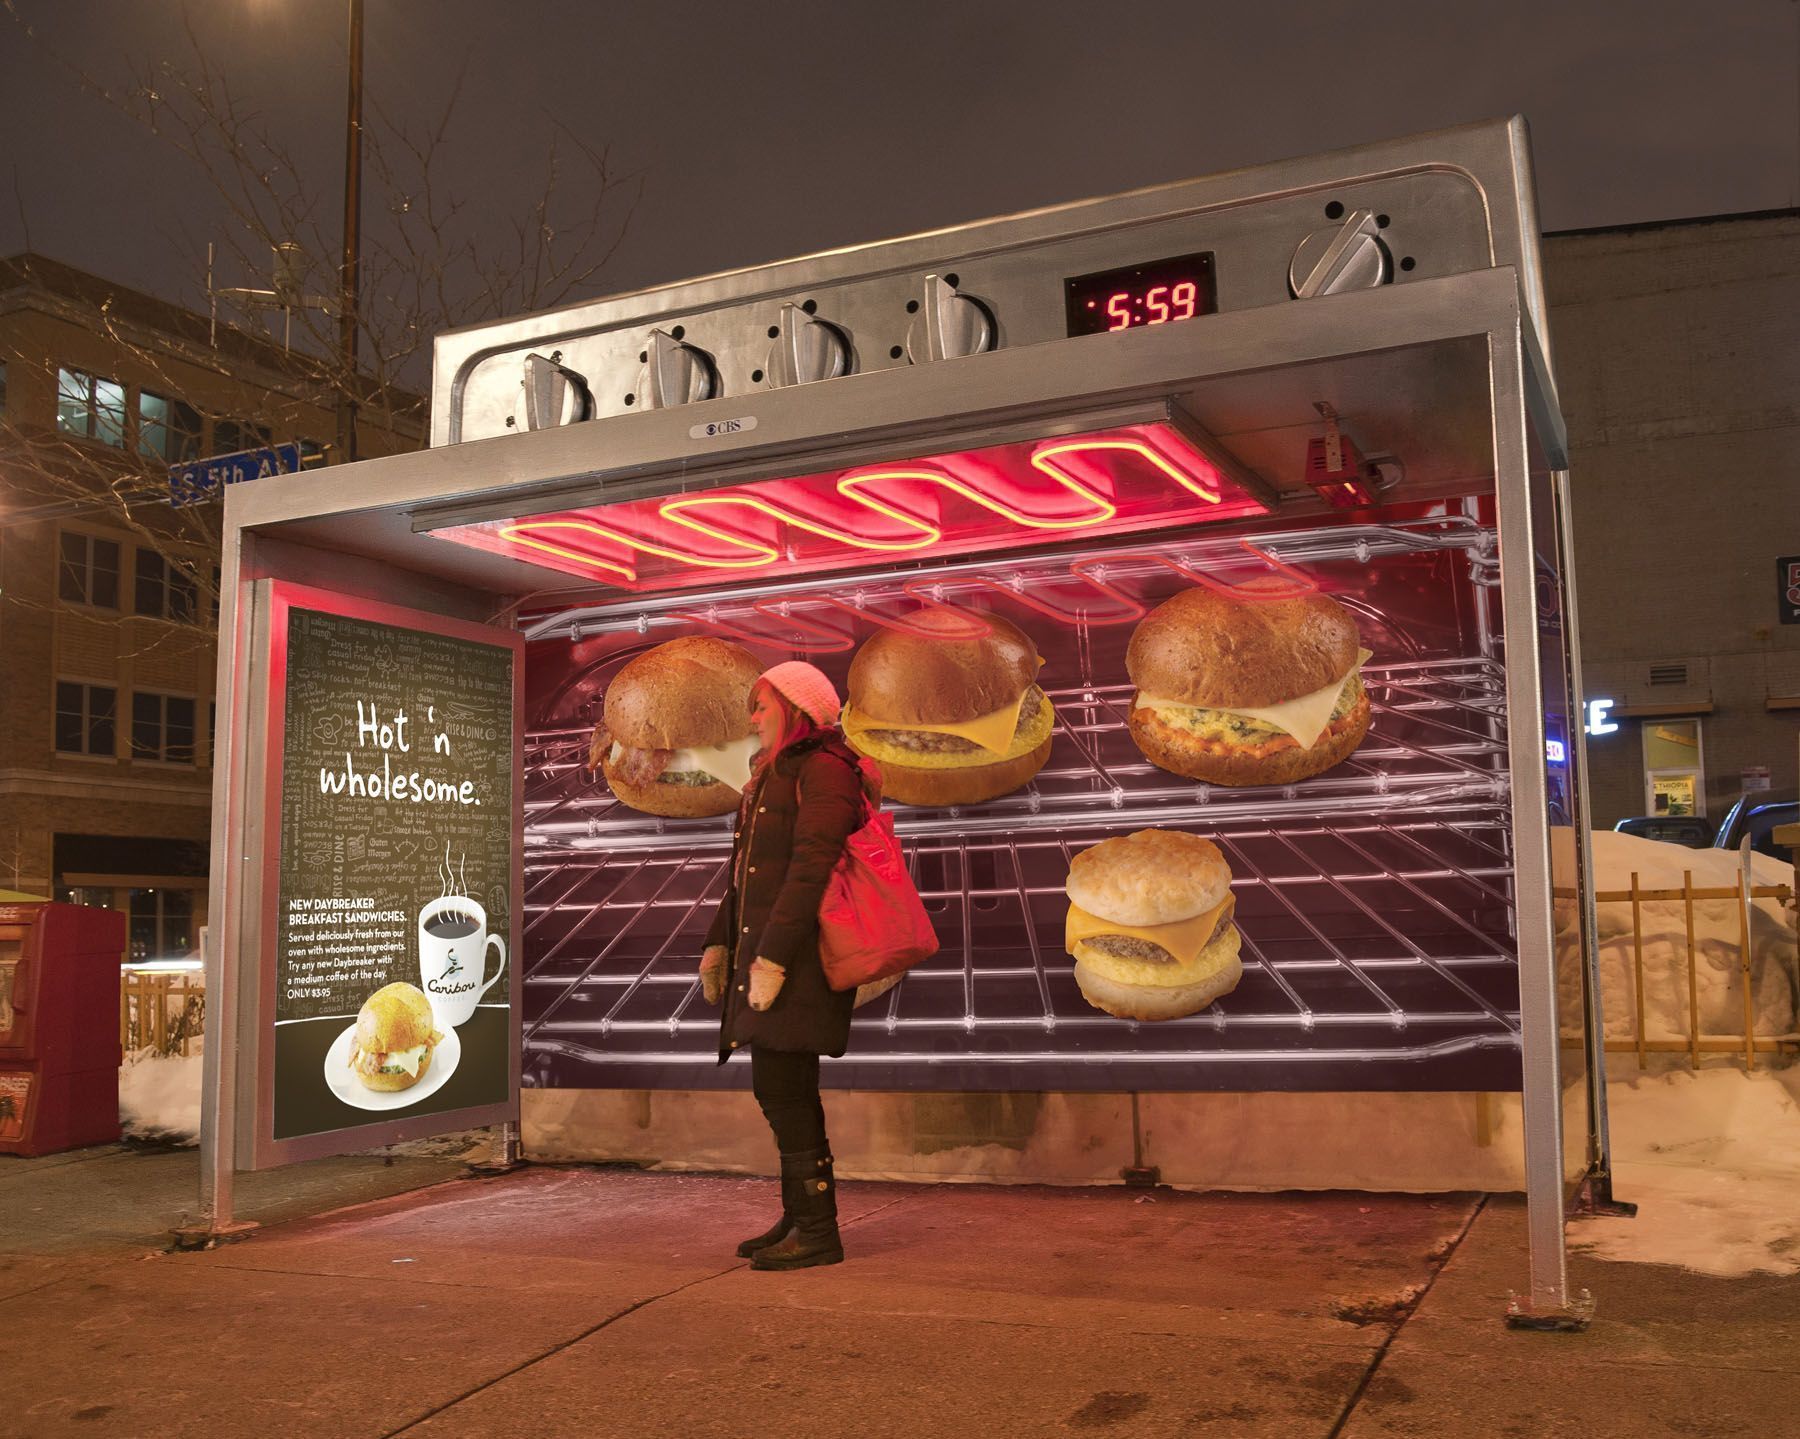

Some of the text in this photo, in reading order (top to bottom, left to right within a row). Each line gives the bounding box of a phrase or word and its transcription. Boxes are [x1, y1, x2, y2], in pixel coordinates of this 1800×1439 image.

[1108, 283, 1196, 332] 5:59
[718, 420, 741, 433] CBS
[204, 465, 244, 492] 5th
[357, 700, 410, 753] Hot
[320, 752, 481, 805] wholesome.
[289, 899, 313, 911] NEW
[314, 897, 375, 910] DAYBREAKER
[289, 911, 407, 926] BREAKFAST SANDWICHES.
[288, 928, 405, 943] Served deliciously fresh from our
[288, 941, 407, 957] oven with wholesome ingredients.
[287, 955, 393, 971] Try any new Daybreaker with
[293, 974, 324, 985] medium
[325, 971, 349, 981] coffee
[350, 970, 359, 980] of
[360, 969, 372, 980] the
[373, 968, 388, 980] day.
[287, 987, 331, 1000] ONLY $3.95
[428, 979, 476, 995] Caribou
